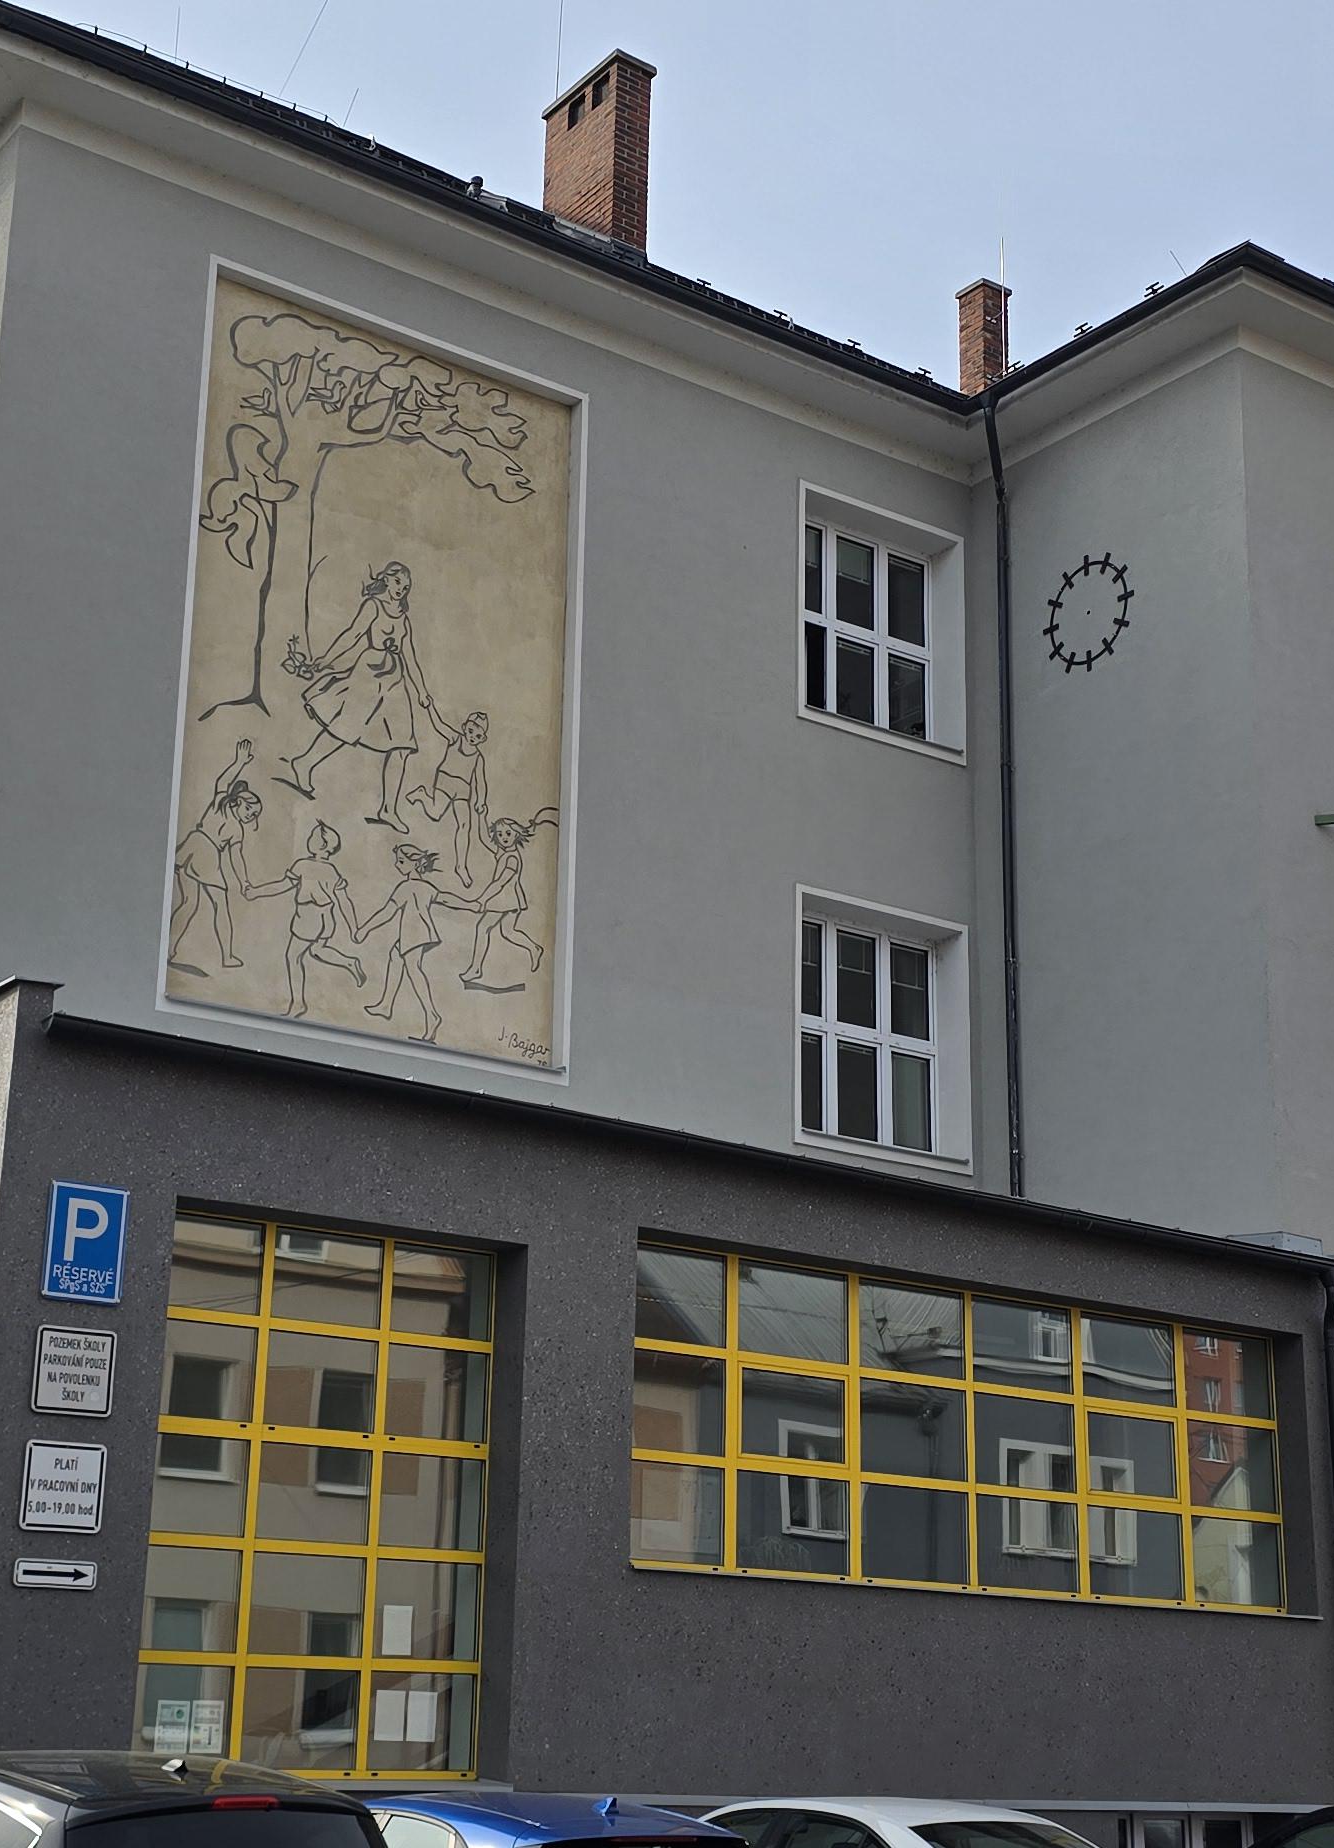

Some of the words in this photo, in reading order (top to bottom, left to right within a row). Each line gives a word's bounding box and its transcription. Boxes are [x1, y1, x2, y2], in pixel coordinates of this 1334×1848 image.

[64, 1198, 108, 1261] P
[53, 1262, 114, 1284] RÉSERVÉ
[49, 1336, 82, 1350] POZEMEK
[83, 1337, 106, 1352] ŠKOLY
[43, 1353, 84, 1367] PARKOVÁNÍ
[85, 1357, 107, 1370] POUZE
[47, 1372, 57, 1383] NA
[62, 1387, 85, 1402] ŠKOLY
[54, 1457, 79, 1471] PLATÍ
[30, 1479, 36, 1490] V
[37, 1479, 79, 1493] PRACOVNÍ
[81, 1482, 97, 1494] DNY
